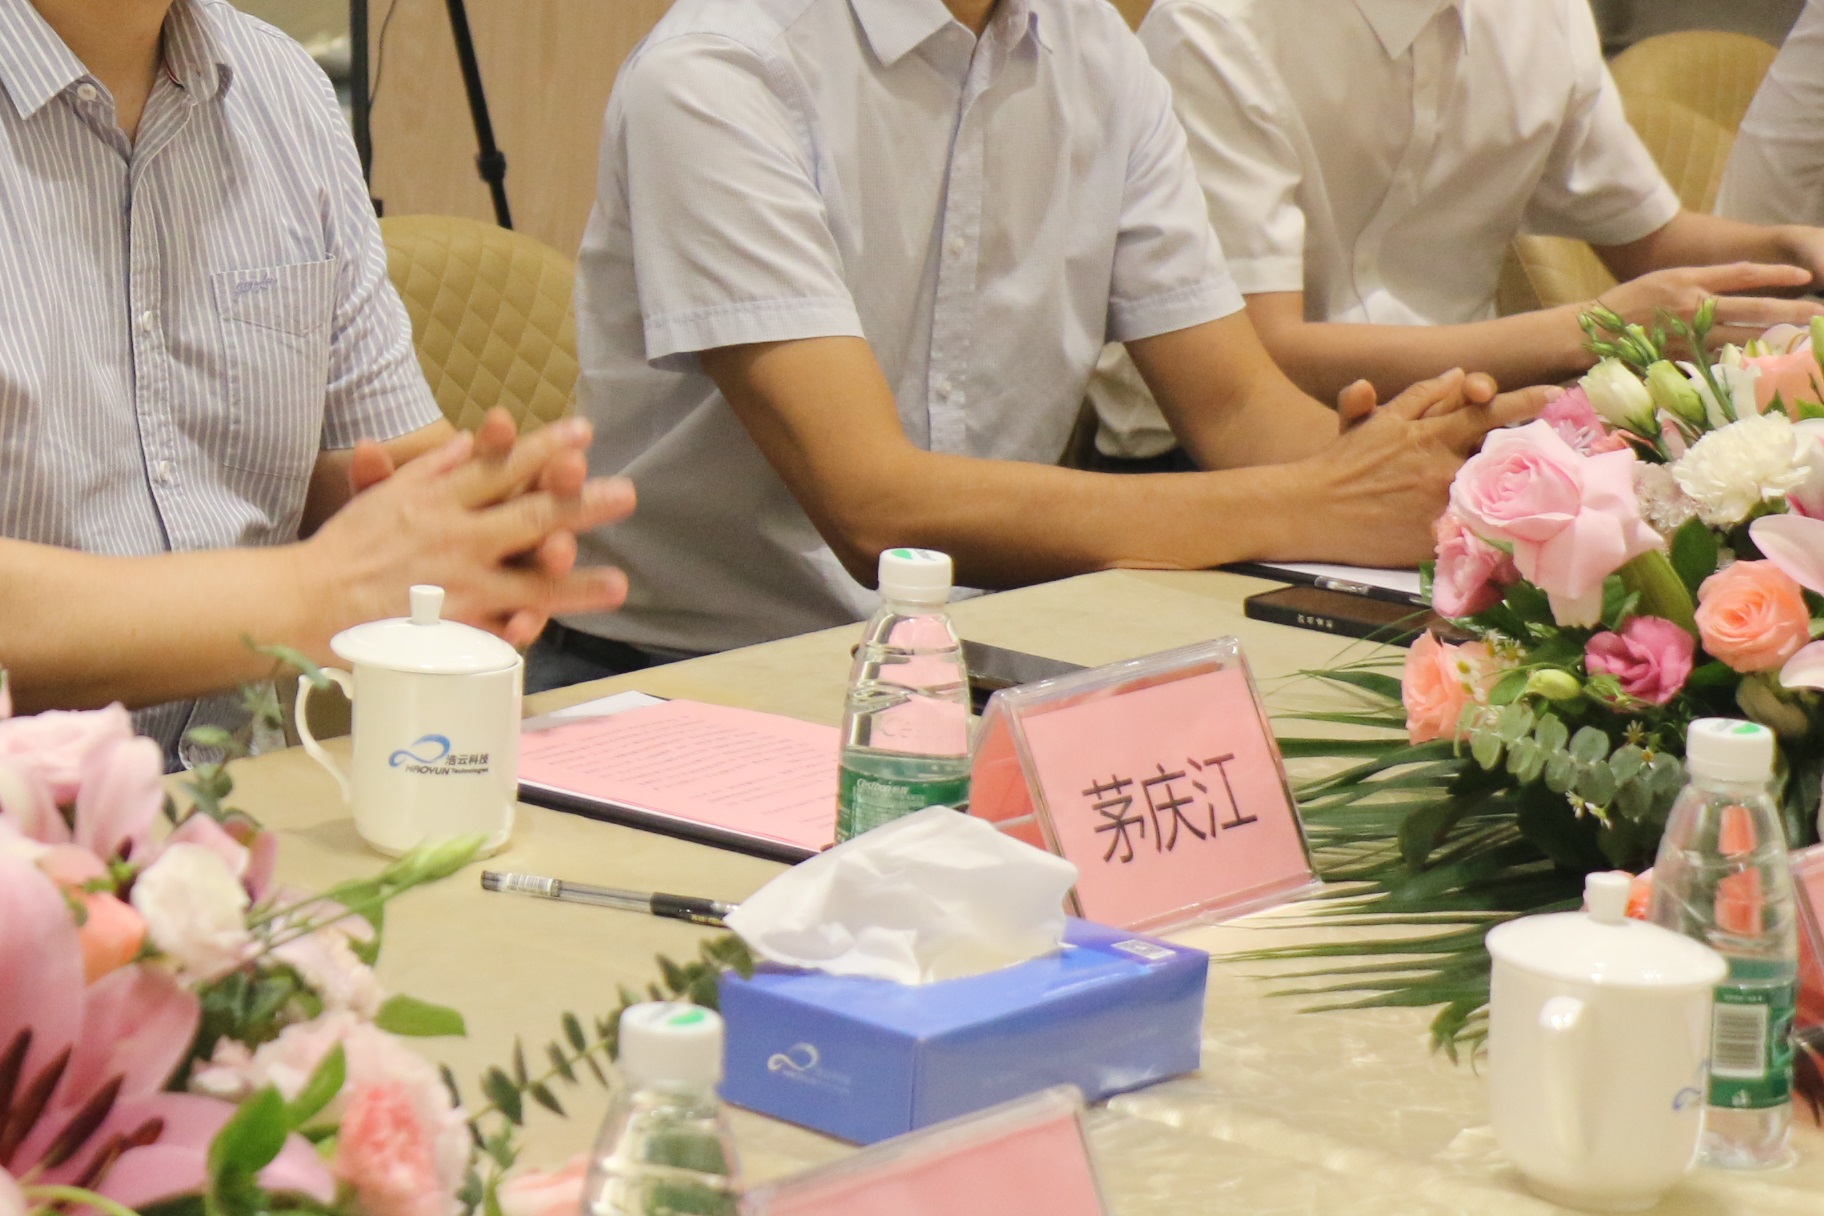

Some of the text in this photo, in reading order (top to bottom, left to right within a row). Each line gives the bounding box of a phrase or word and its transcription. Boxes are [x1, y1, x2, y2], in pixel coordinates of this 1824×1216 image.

[446, 753, 489, 765] 浩云科技
[1082, 753, 1258, 863] 茅庆江
